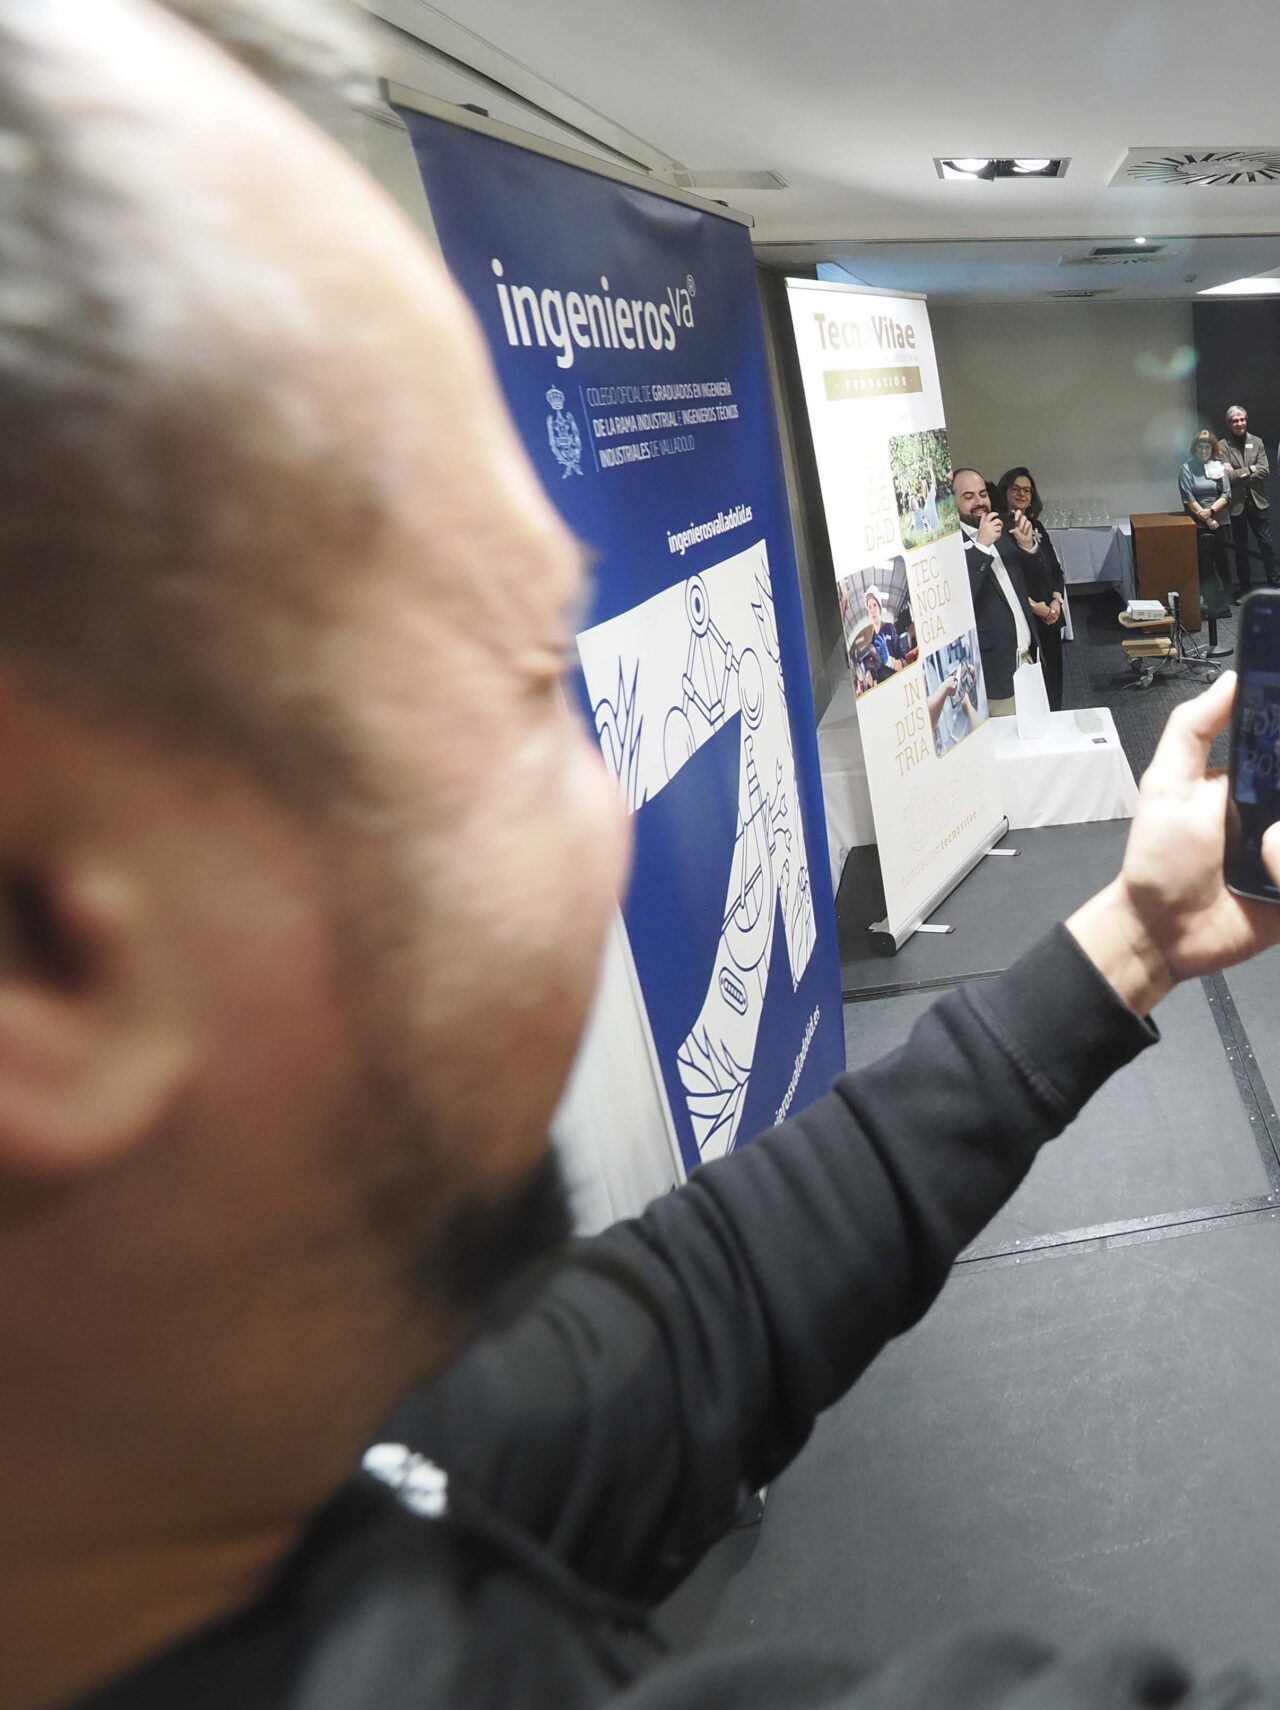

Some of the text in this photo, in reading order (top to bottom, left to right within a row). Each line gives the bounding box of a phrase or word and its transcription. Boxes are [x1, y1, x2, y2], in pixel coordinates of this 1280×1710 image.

[491, 258, 676, 368] ingenieros
[813, 312, 916, 350] TecnVitae
[651, 383, 693, 402] GRADUADOS
[592, 418, 607, 438] DE
[605, 417, 617, 436] LA
[616, 415, 638, 434] RAMA
[637, 411, 678, 432] INDUSTRIAL
[682, 407, 717, 424] INGENIEROS
[599, 441, 651, 469] INDUSTRIALES
[864, 517, 896, 552] DAD
[911, 555, 940, 586] TEC
[916, 579, 952, 617] NOLO
[903, 677, 921, 708] IN
[895, 707, 926, 746] DUS
[895, 736, 930, 777] TRIA
